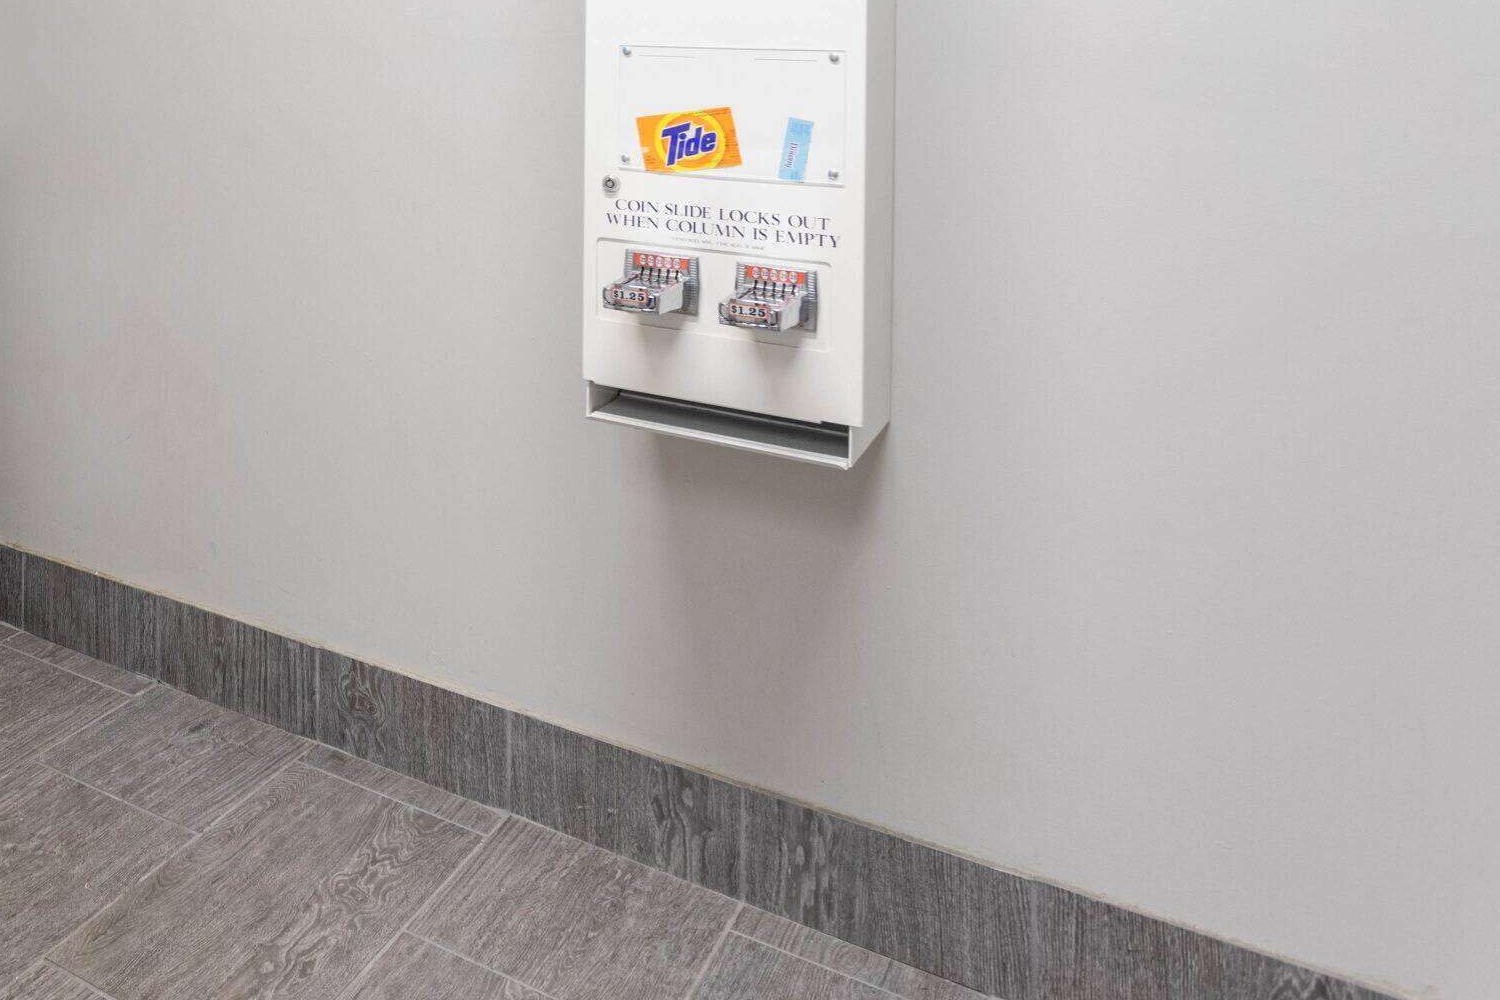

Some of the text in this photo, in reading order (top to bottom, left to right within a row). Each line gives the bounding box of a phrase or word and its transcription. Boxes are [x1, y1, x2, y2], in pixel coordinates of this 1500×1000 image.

[661, 122, 717, 166] Tide
[606, 212, 659, 229] WHEN
[666, 218, 745, 239] COLUMN
[753, 228, 768, 241] IS
[775, 231, 840, 249] EMPTY
[615, 199, 831, 231] COIN SLIDE LOCKS OUT
[613, 290, 645, 302] $1.25
[731, 305, 766, 318] $1.25
